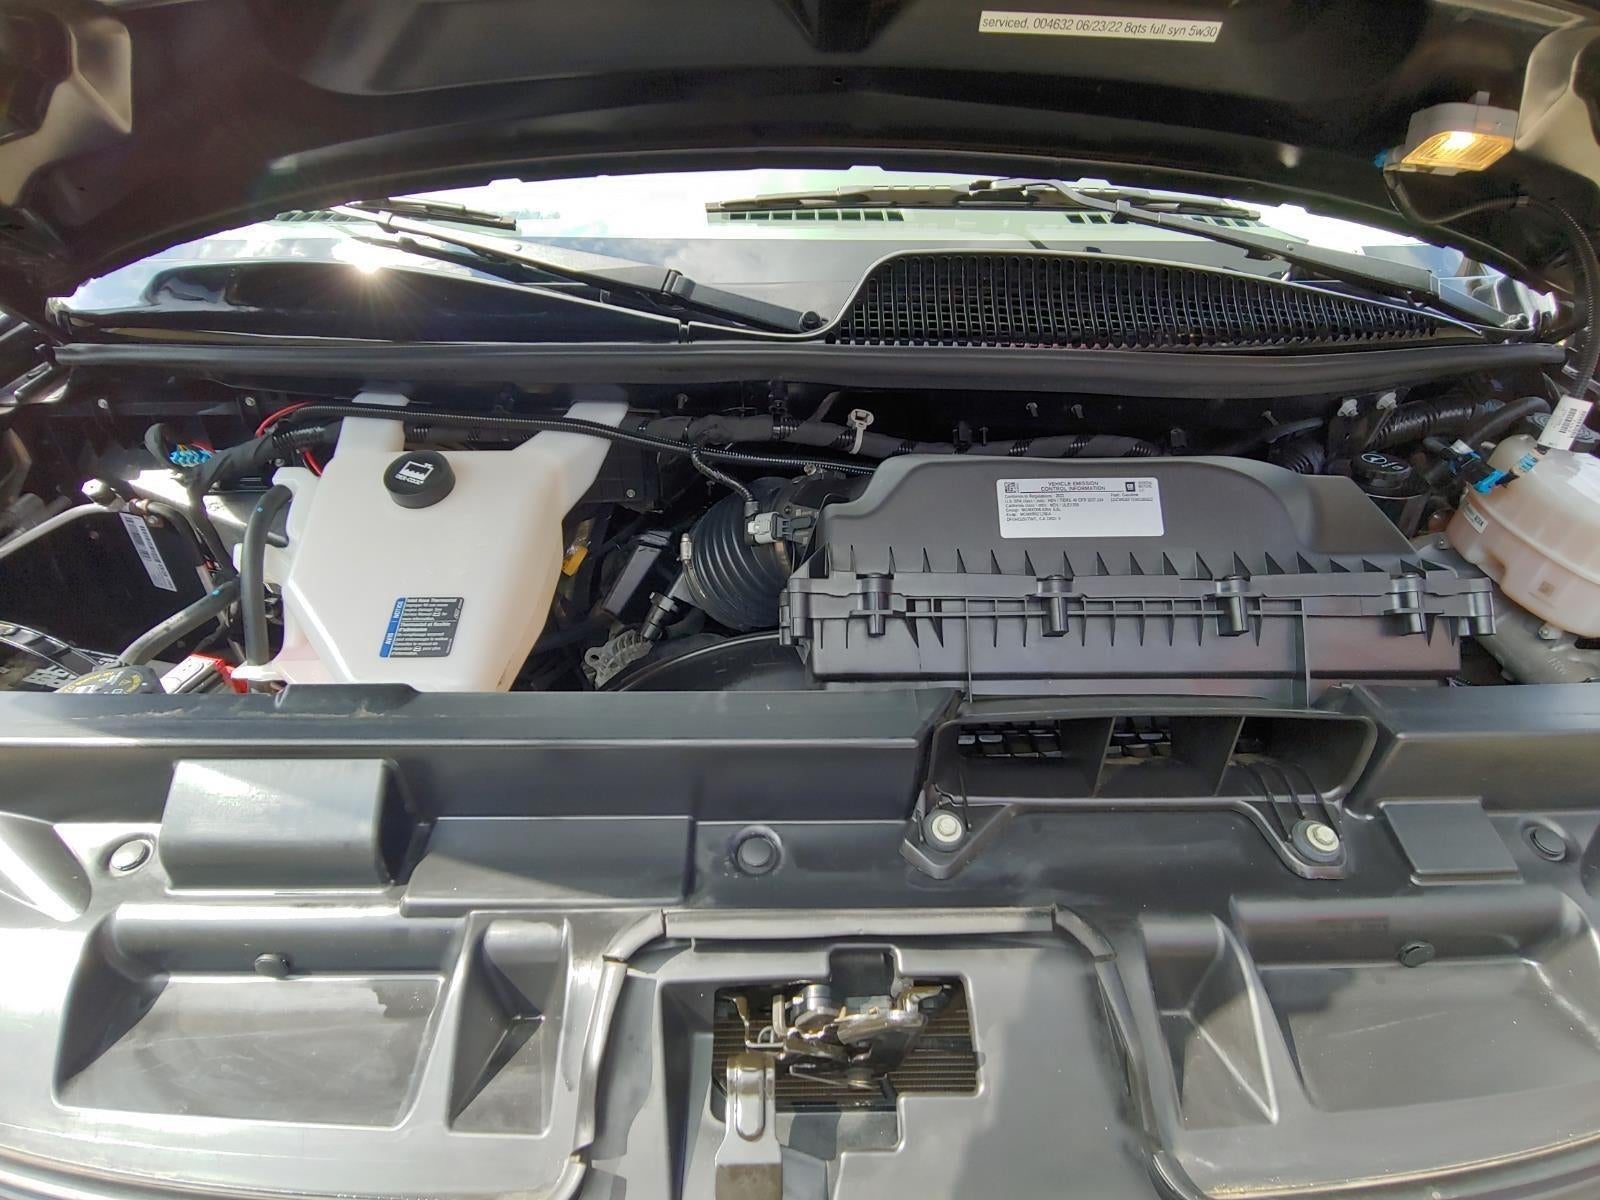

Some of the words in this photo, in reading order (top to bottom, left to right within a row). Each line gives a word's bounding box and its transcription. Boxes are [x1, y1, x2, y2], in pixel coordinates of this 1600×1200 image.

[1033, 17, 1074, 31] 004632
[1075, 19, 1123, 33] 06/23/22
[1124, 22, 1147, 35] 8qts
[1149, 22, 1167, 34] full
[1167, 27, 1187, 38] syn
[1188, 25, 1218, 37] 5w30
